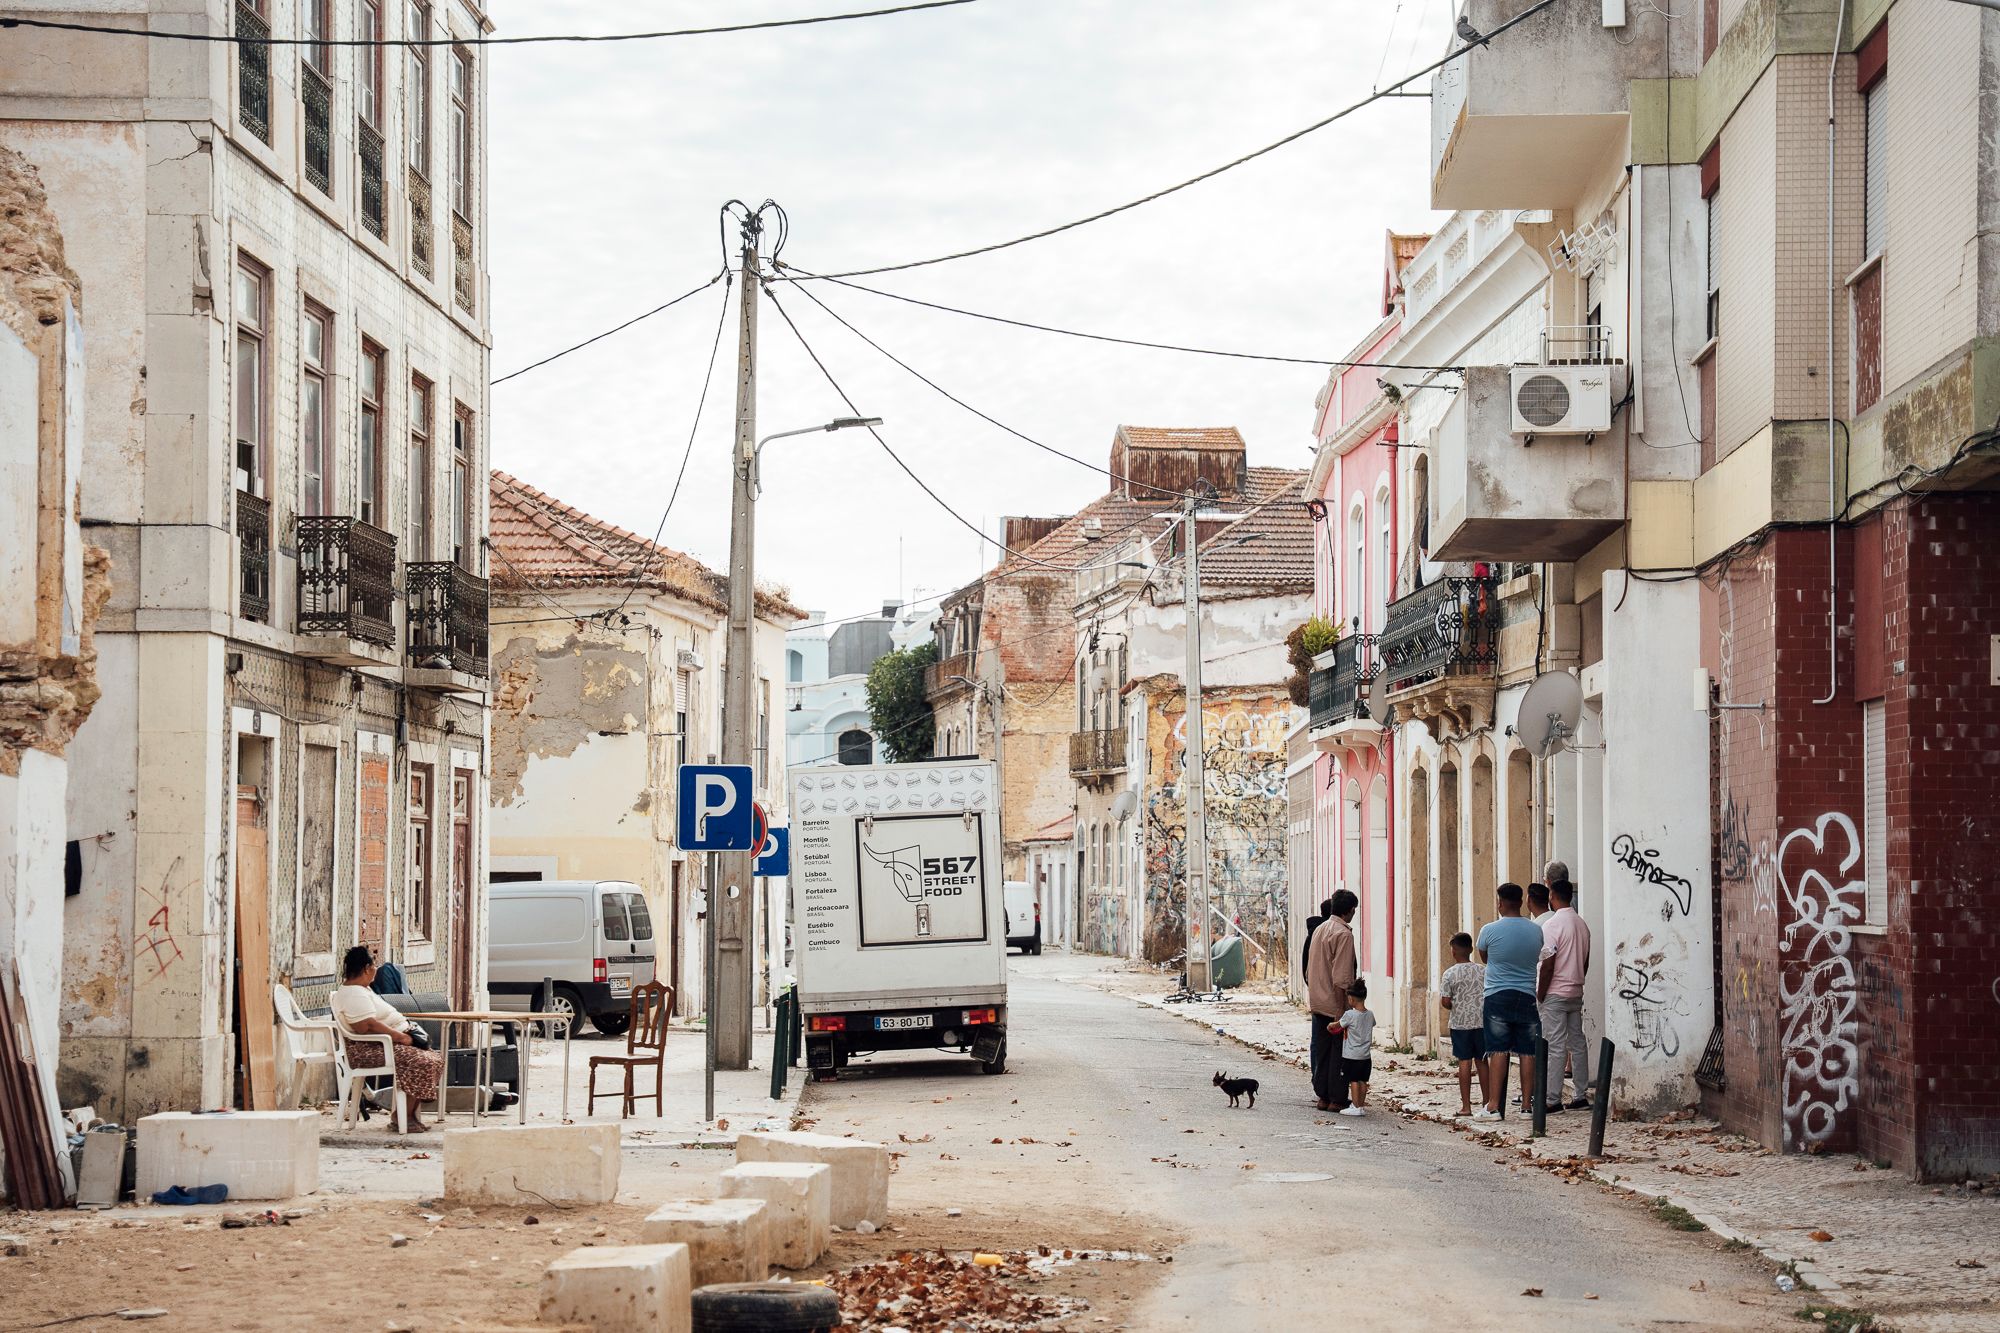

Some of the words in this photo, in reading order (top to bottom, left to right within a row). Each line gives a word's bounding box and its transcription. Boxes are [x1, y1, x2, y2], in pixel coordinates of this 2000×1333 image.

[695, 774, 737, 841] P
[753, 833, 779, 871] P
[923, 856, 977, 875] 567
[924, 876, 977, 886] STREET
[924, 887, 962, 897] FOOD
